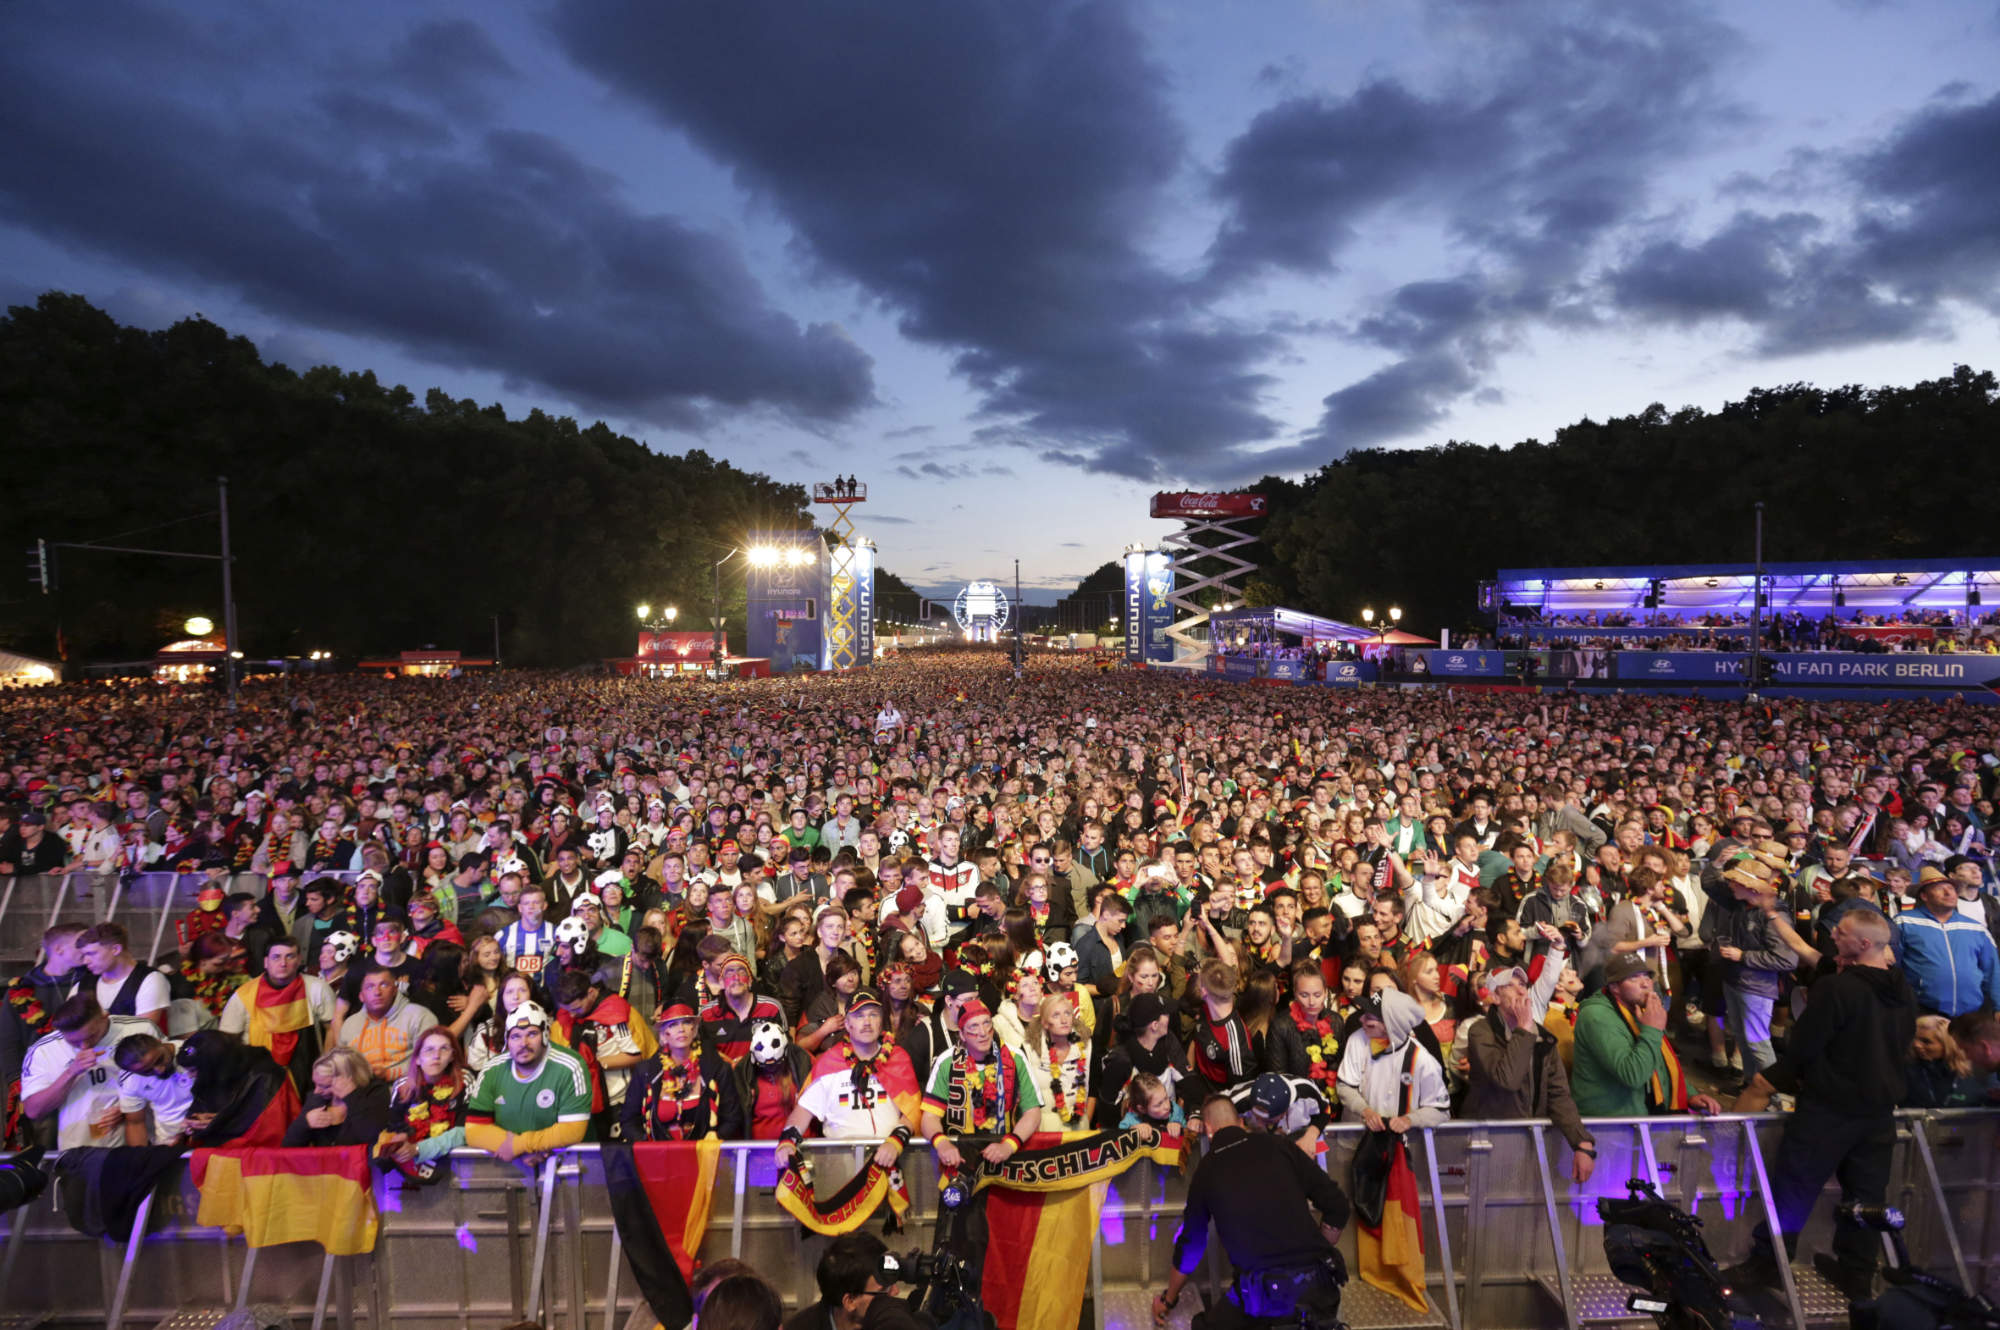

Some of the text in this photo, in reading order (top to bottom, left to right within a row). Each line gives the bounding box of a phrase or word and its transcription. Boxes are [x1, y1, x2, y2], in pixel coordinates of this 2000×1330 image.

[1715, 661, 1964, 678] HYAI FAN PARK BERLIN
[520, 958, 538, 970] DB
[88, 1067, 106, 1086] 10
[851, 1087, 875, 1110] 12
[975, 1128, 1162, 1184] UTSCHLAND
